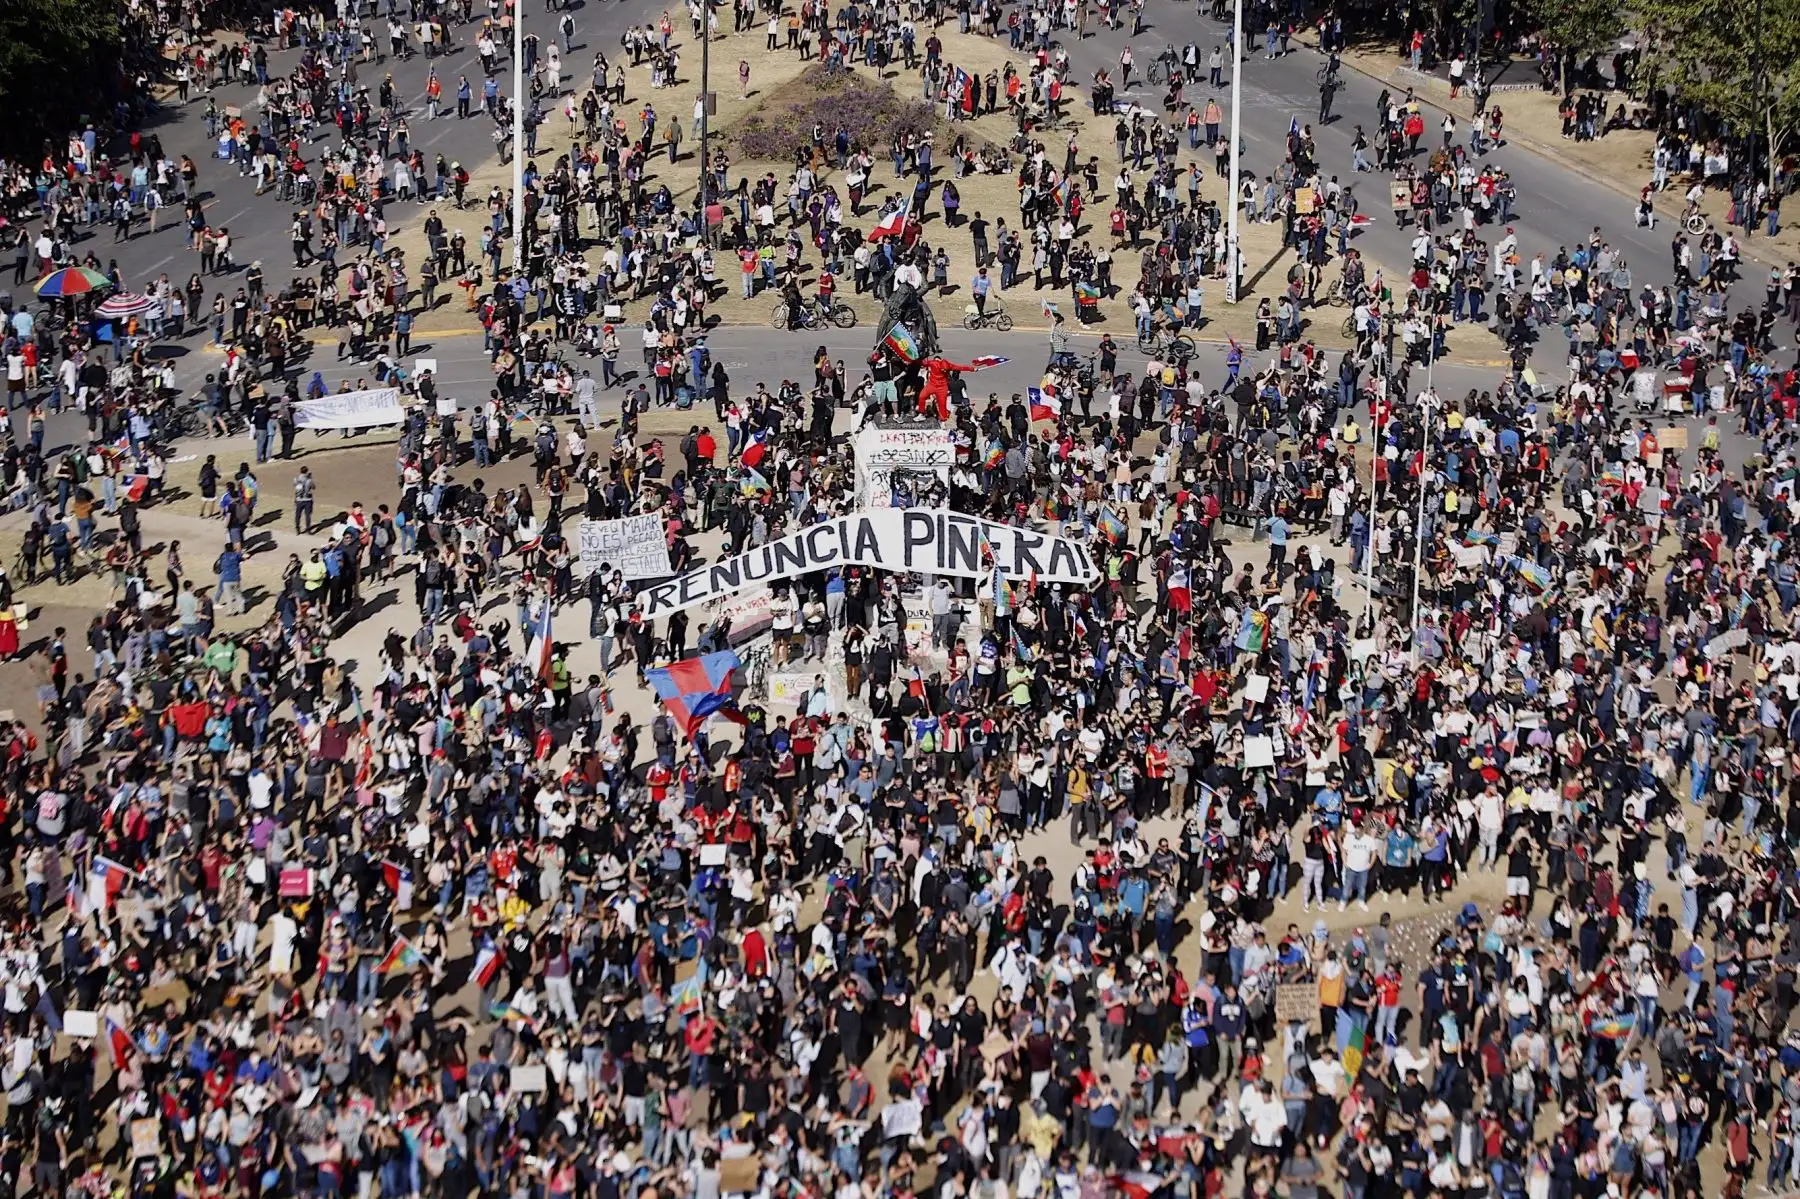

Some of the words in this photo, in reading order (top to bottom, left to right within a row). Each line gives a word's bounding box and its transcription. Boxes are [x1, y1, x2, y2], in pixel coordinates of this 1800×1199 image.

[580, 523, 596, 535] SE
[621, 514, 659, 536] MATAR
[581, 536, 599, 549] NO
[603, 535, 622, 549] ES
[627, 530, 662, 544] PECADO
[621, 553, 668, 576] ESTADO
[647, 517, 883, 616] RENUNCIA
[903, 512, 1090, 578] PIÑERA!
